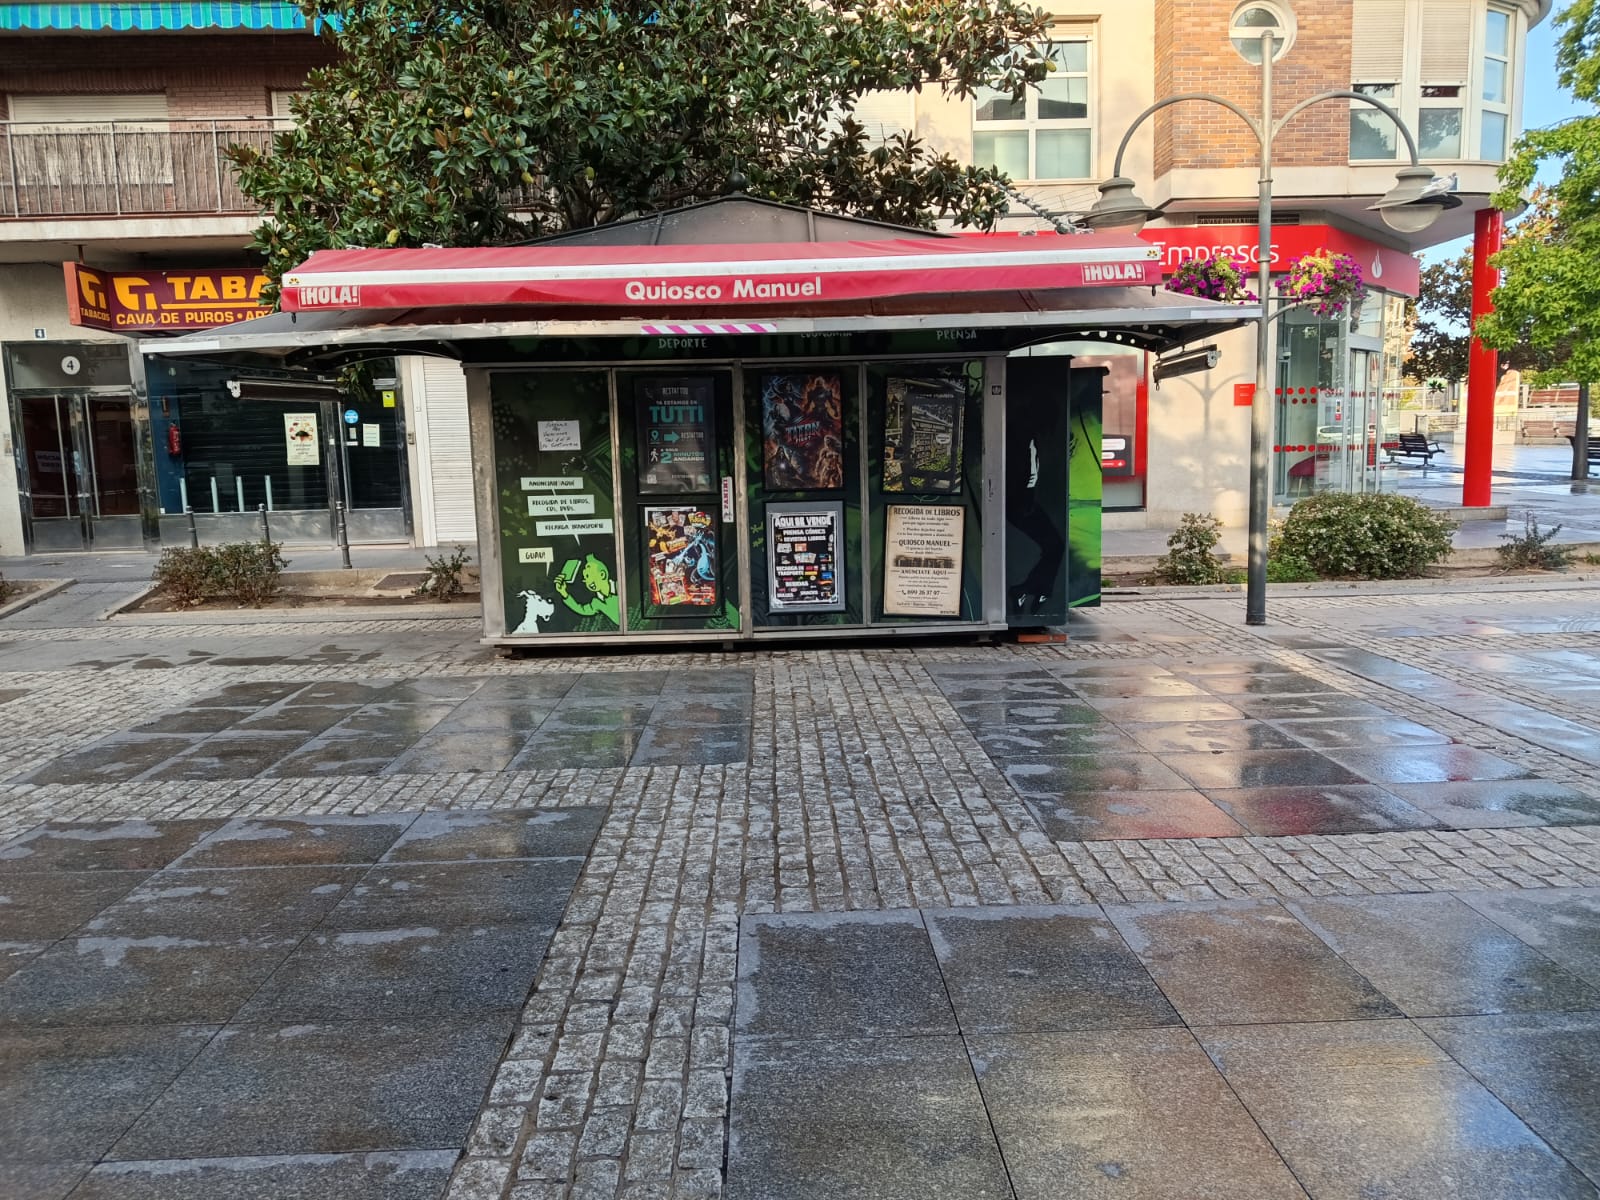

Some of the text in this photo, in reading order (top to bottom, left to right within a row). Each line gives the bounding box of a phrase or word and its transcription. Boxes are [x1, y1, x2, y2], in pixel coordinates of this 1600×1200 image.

[1084, 264, 1143, 281] ¡HOLA!
[625, 276, 822, 300] Quiosco Manuel
[300, 286, 358, 305] ¡HOLA!
[80, 307, 110, 322] TABACOS
[116, 311, 155, 325] CAVA
[160, 311, 180, 324] DE
[185, 311, 234, 323] PUROS
[36, 329, 43, 338] 4
[936, 329, 977, 340] PRENSA
[658, 337, 708, 349] DEPORTE
[66, 360, 74, 371] 4
[649, 405, 704, 423] TUTTI
[660, 451, 672, 464] 2
[893, 507, 924, 515] RECOGIDA
[934, 509, 960, 517] LIBROS
